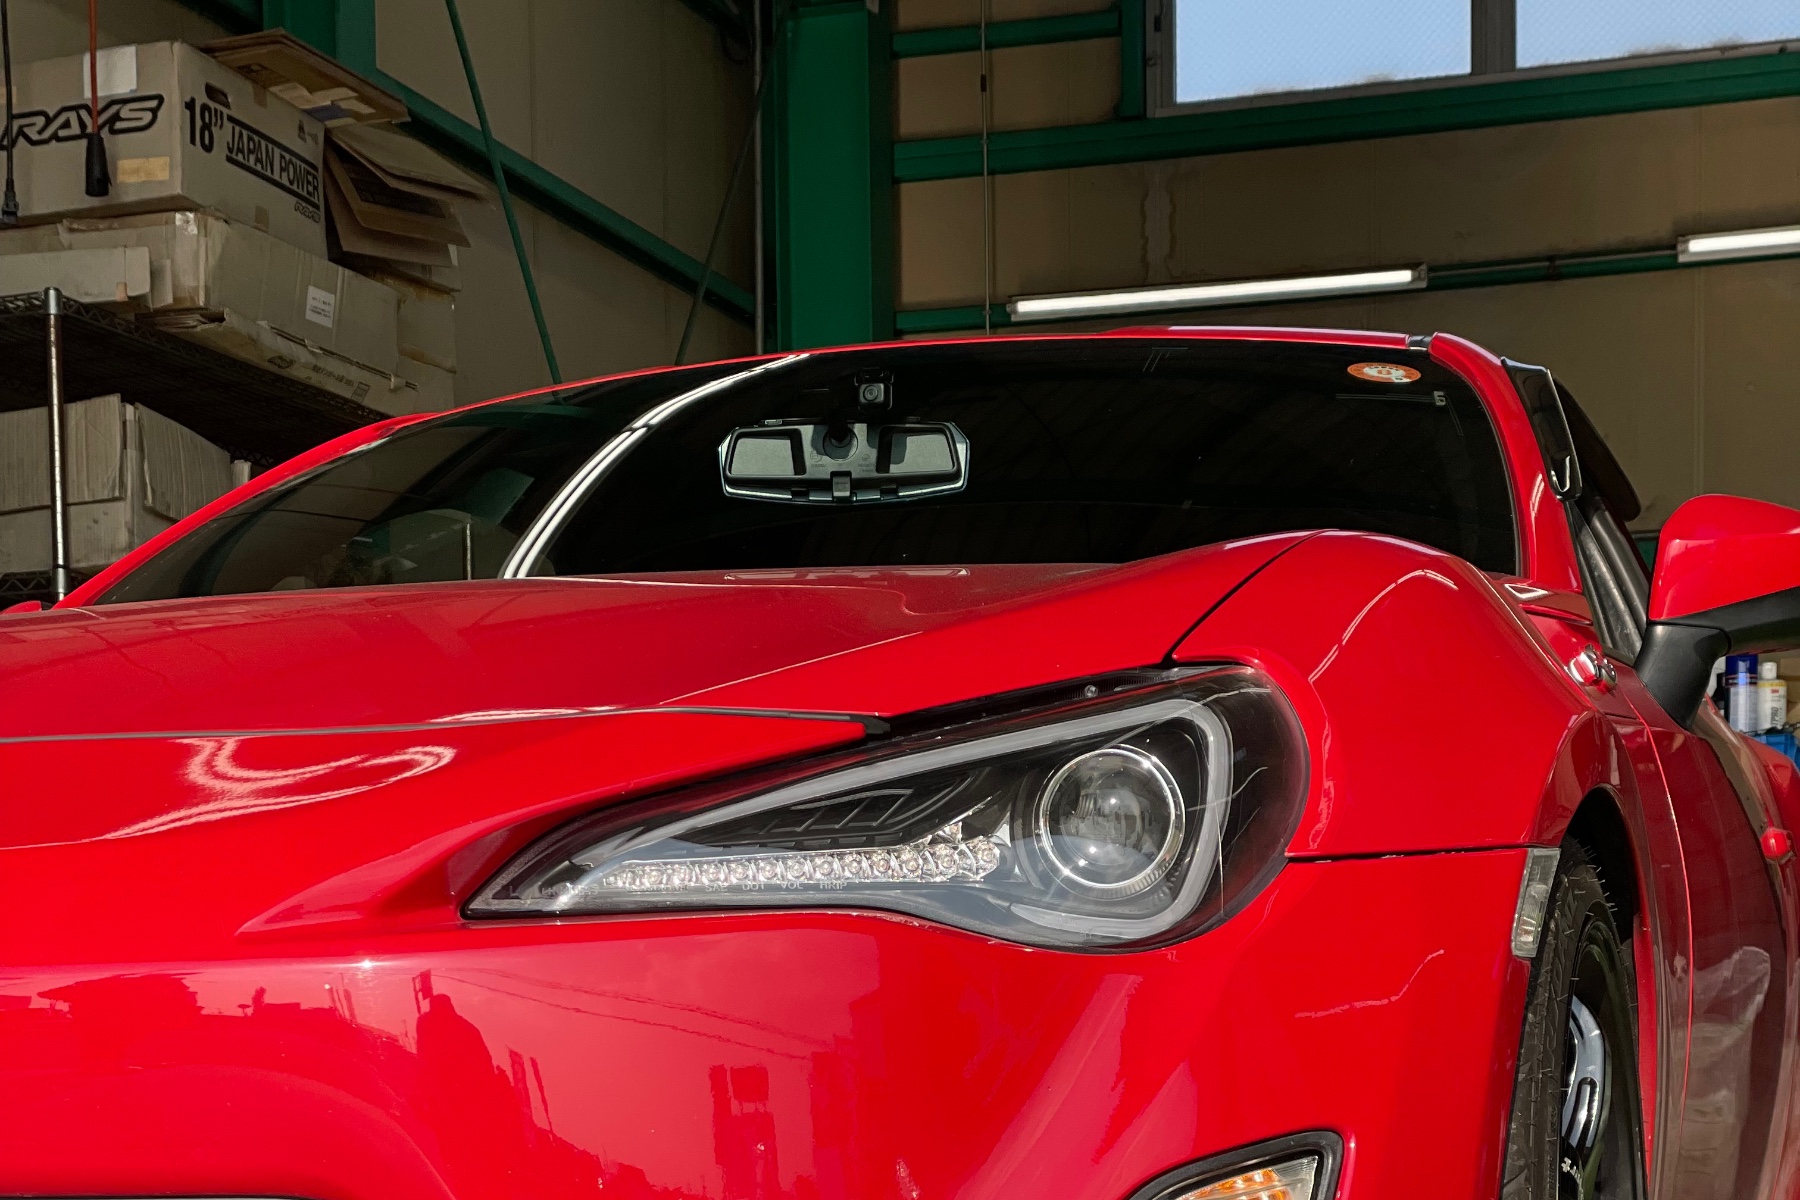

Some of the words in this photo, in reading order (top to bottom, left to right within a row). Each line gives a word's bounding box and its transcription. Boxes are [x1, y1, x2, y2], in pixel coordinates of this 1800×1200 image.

[0, 93, 165, 150] RAYS
[227, 125, 275, 176] JAPAN
[279, 152, 320, 203] POWER
